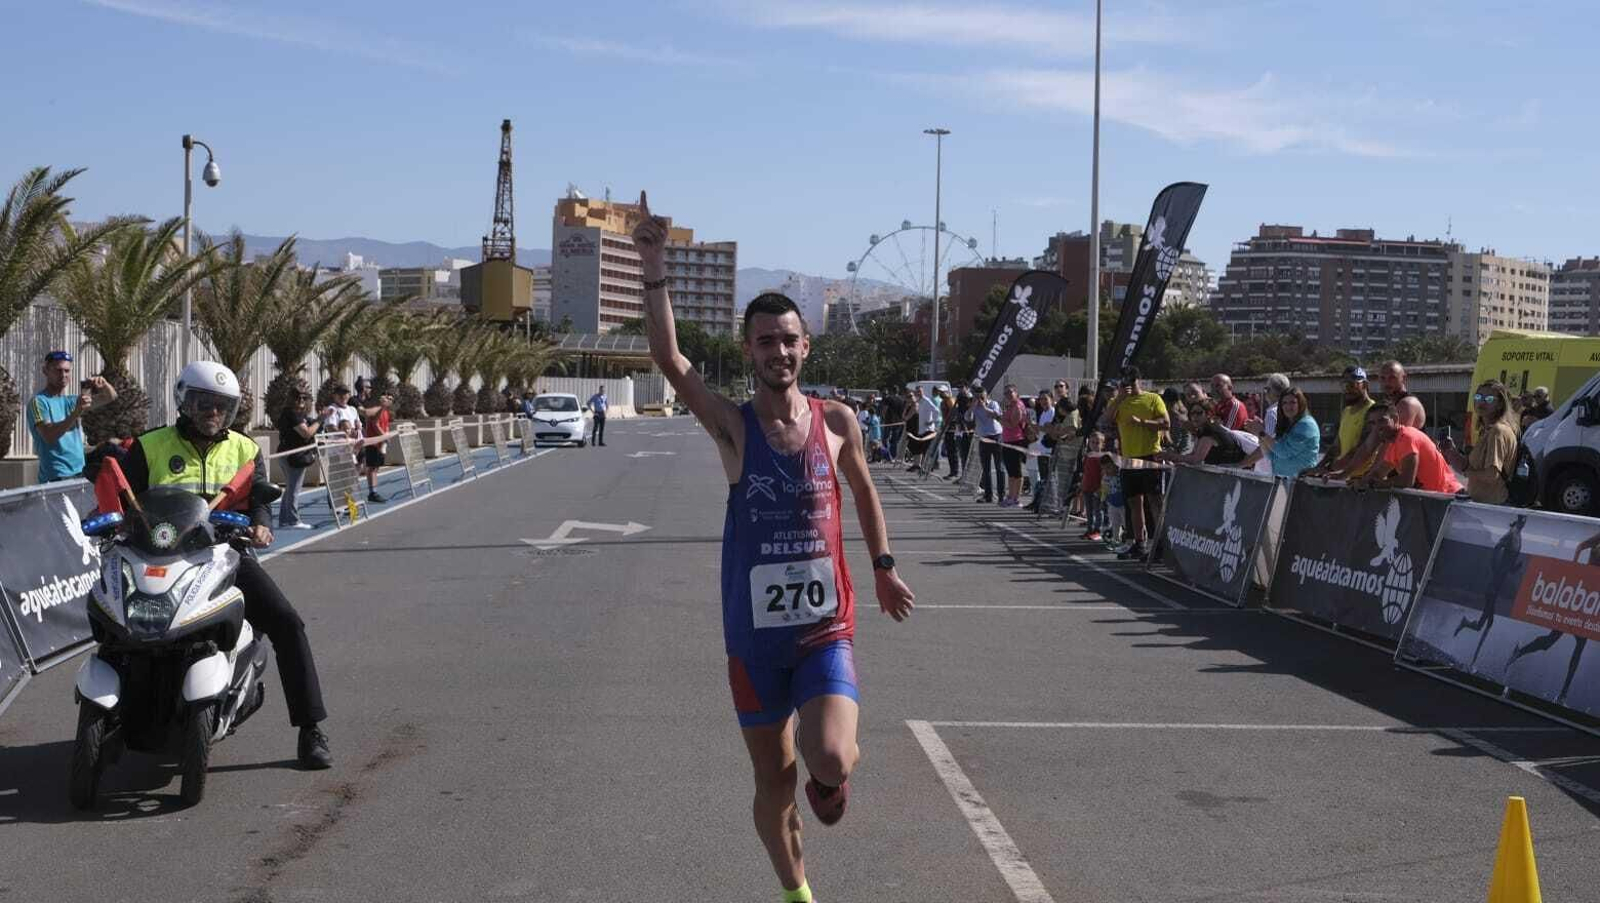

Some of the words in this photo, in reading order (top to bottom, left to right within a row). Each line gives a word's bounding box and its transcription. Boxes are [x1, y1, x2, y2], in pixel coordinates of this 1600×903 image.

[1501, 352, 1534, 361] SOPORTE
[1535, 352, 1555, 361] VITAL
[773, 528, 819, 541] ATLETISMO
[1166, 524, 1224, 559] aquéatacamos
[761, 540, 825, 555] DELSUR
[1291, 553, 1385, 596] aquéatacamos
[765, 580, 825, 612] 270
